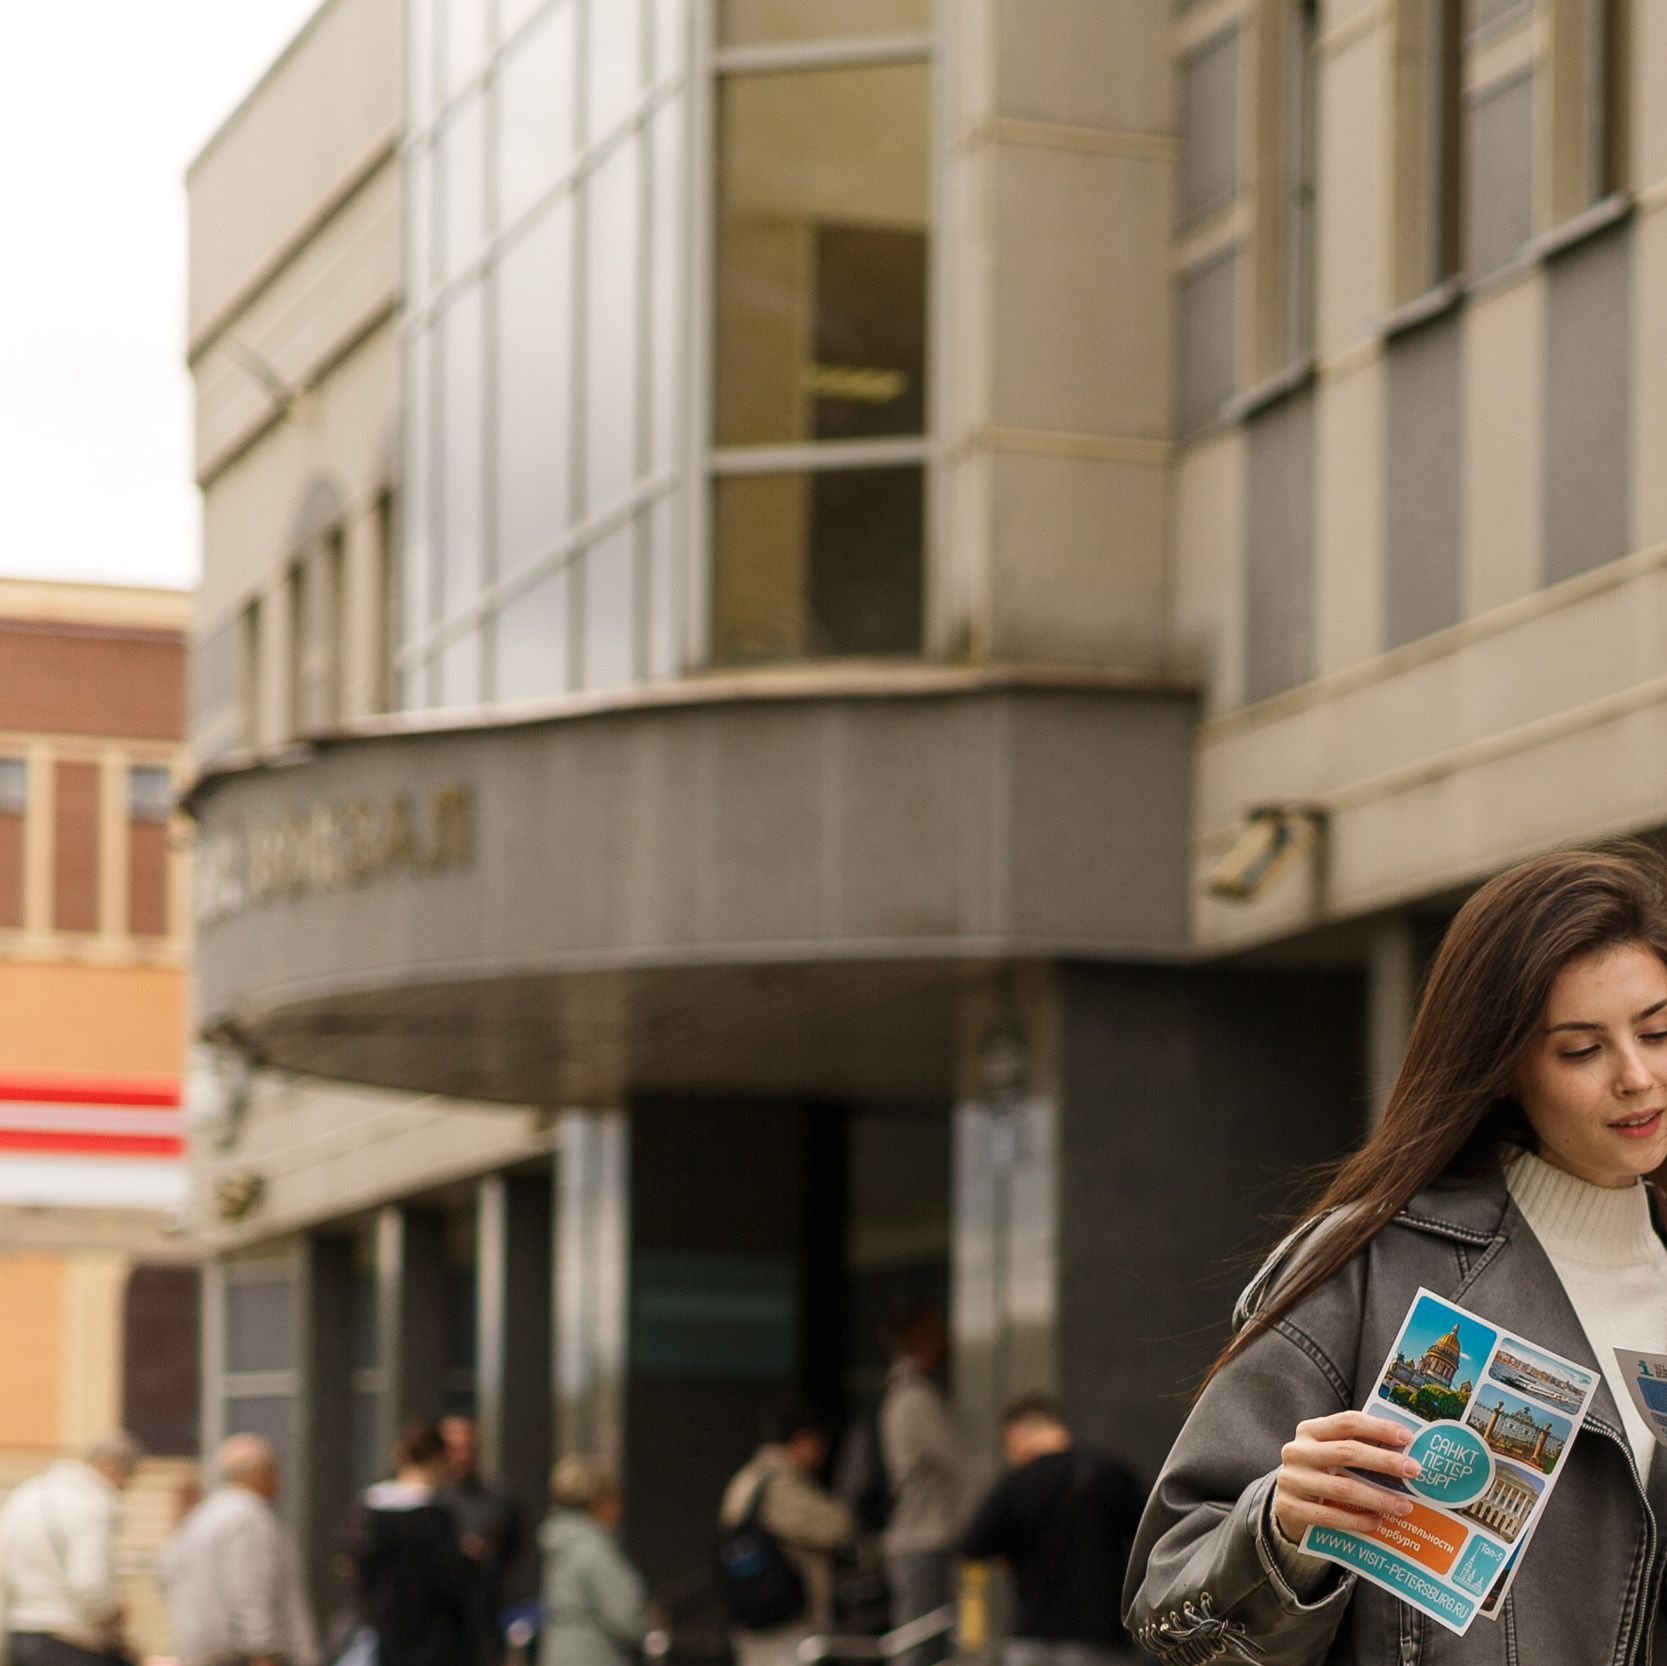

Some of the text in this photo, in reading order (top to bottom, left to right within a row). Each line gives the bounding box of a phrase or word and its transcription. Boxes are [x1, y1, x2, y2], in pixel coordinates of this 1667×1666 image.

[1430, 1434, 1479, 1464] САНКТ
[1421, 1450, 1473, 1479] ПЕТЕР
[1415, 1467, 1457, 1489] БУРГ
[1481, 1542, 1504, 1561] Топ-5
